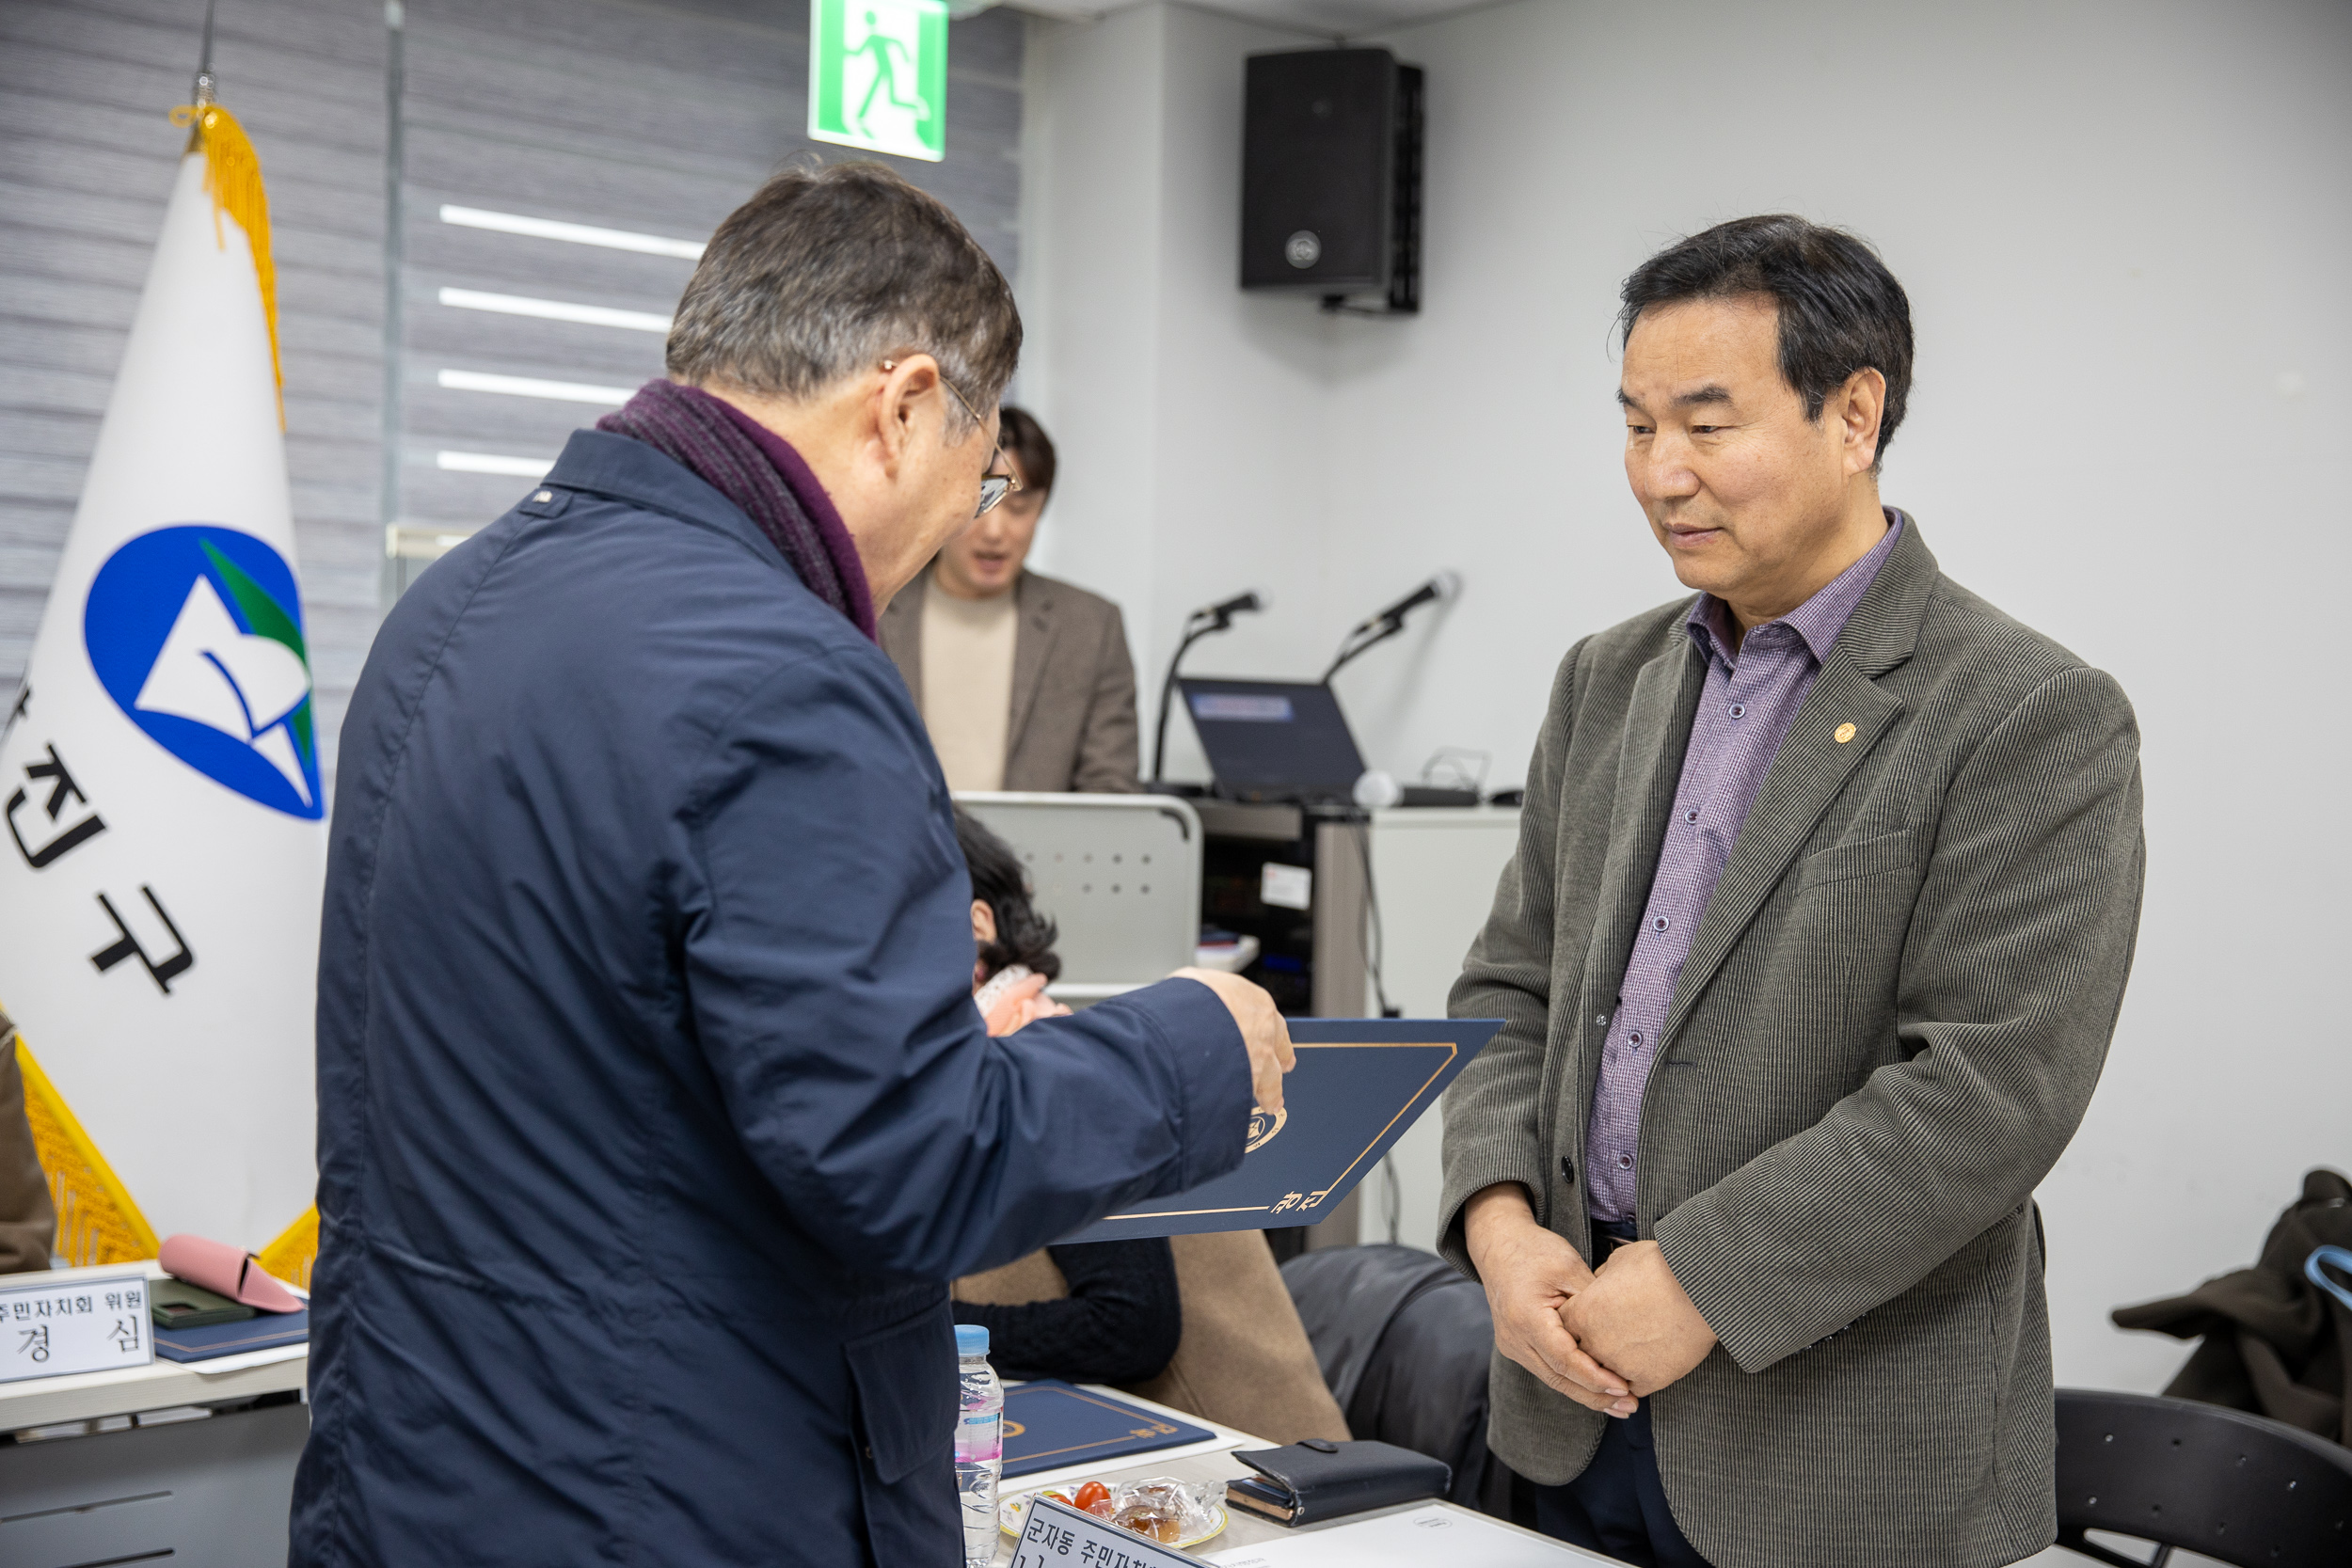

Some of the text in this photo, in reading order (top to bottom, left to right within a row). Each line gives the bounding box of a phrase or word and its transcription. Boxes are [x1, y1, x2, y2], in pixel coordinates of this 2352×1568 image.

[6, 687, 195, 997] 진구
[104, 1290, 141, 1309] 위원
[17, 1314, 139, 1363] 경 심
[1026, 1517, 1156, 1568] 군자동 주민자
